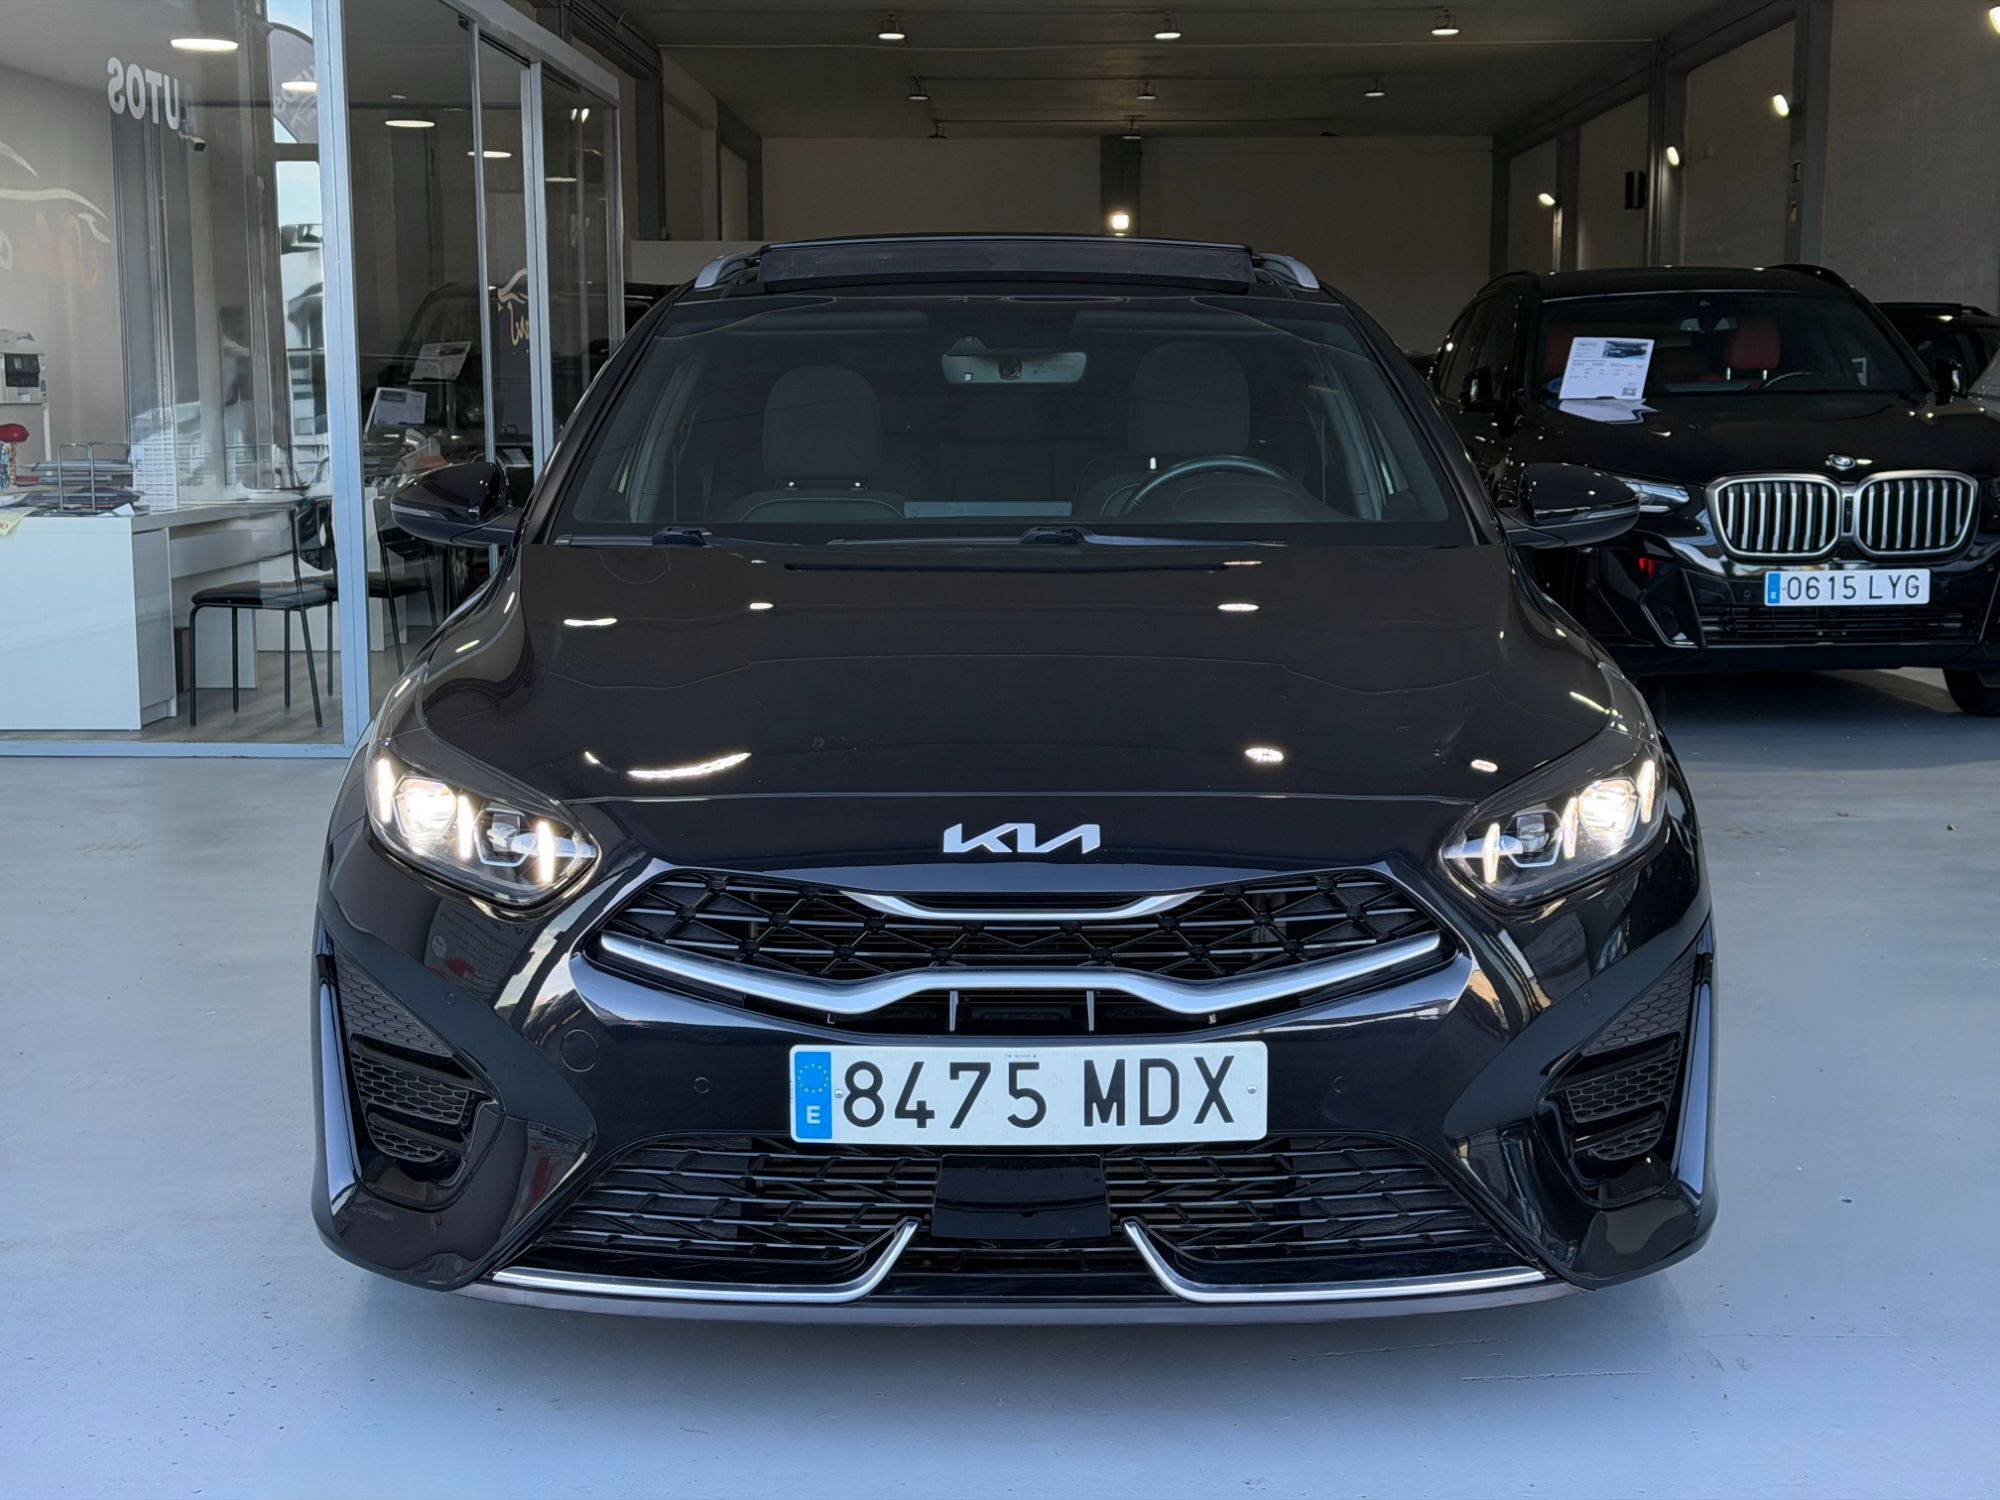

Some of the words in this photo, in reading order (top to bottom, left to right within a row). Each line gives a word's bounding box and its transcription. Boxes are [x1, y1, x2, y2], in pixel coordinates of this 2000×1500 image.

[1770, 591, 1777, 599] E
[1786, 575, 1857, 600] 0615
[1869, 574, 1921, 599] LYG
[943, 822, 1101, 855] KIA
[806, 1105, 821, 1125] E
[842, 1061, 1047, 1130] 8475
[1083, 1055, 1236, 1127] MDX
